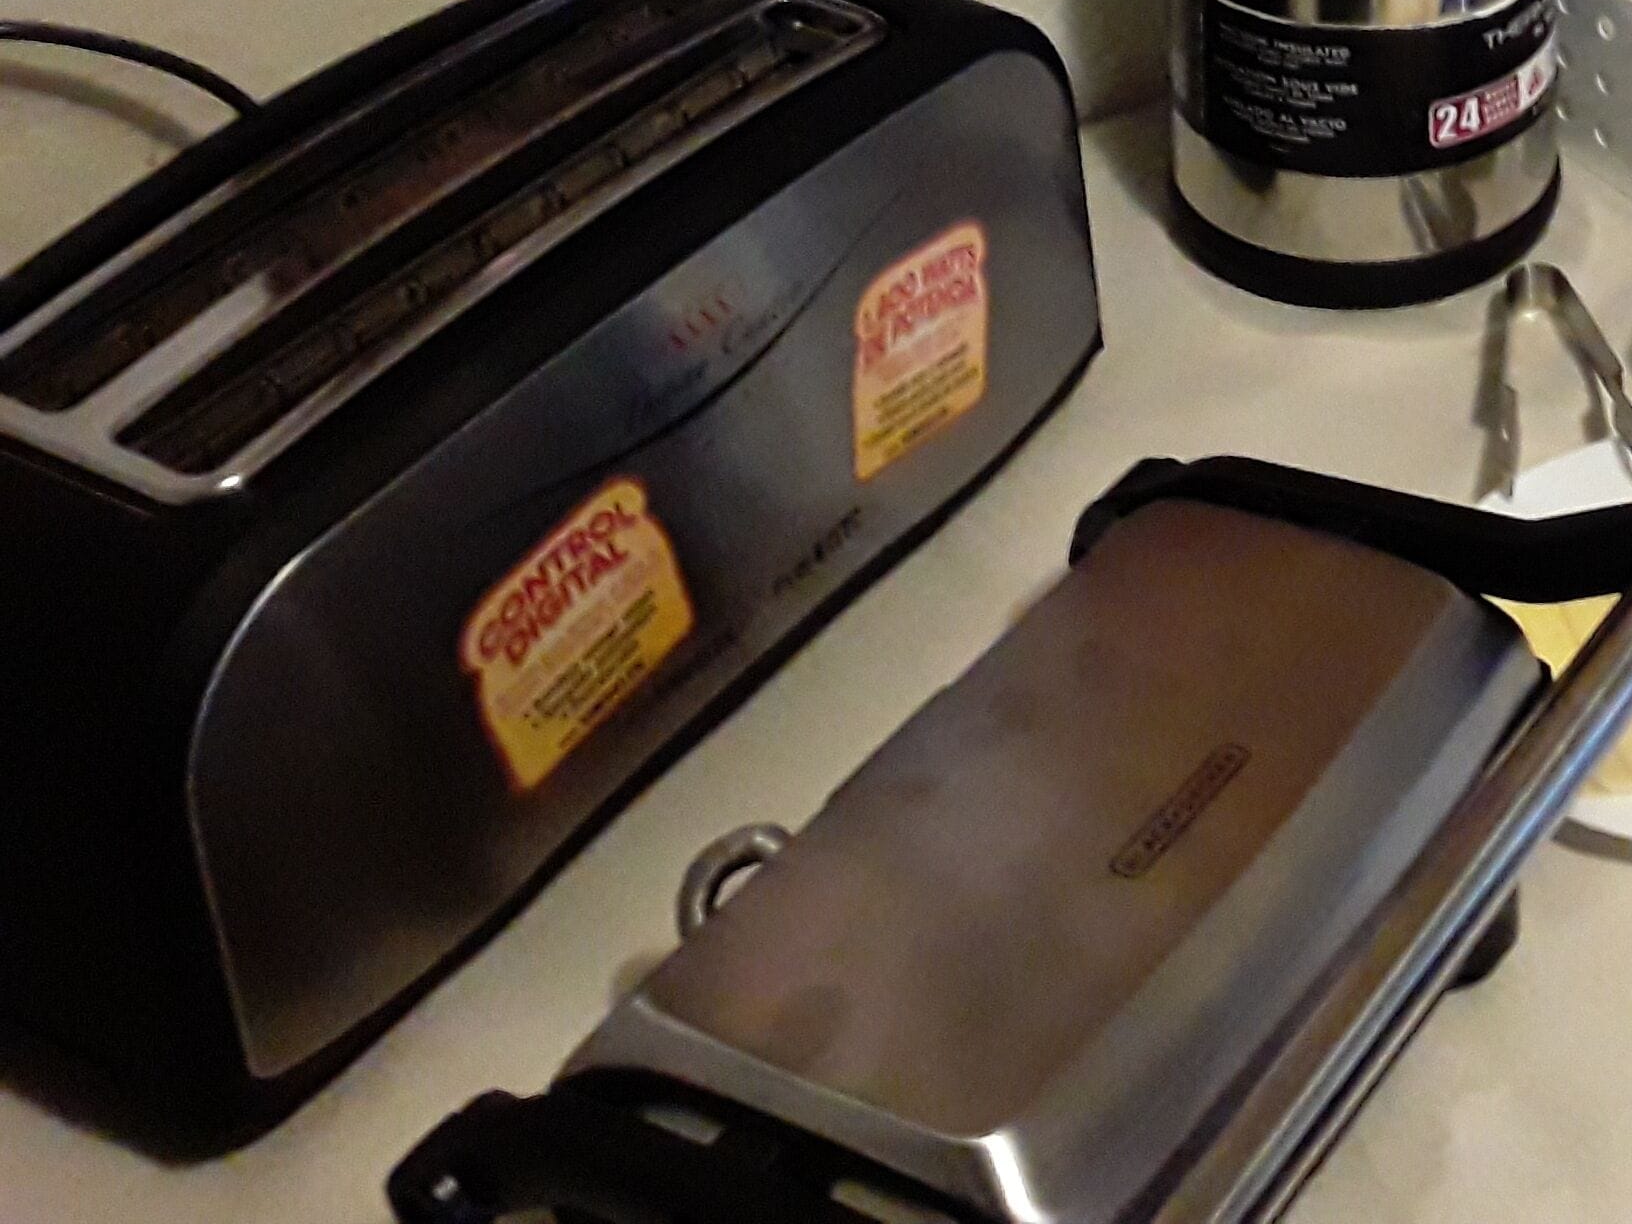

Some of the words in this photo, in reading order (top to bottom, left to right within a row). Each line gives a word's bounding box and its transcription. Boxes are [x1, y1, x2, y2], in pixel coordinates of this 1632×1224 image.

[1436, 96, 1480, 142] 24
[479, 502, 637, 659] CONTROL
[504, 542, 630, 667] DIGITAL
